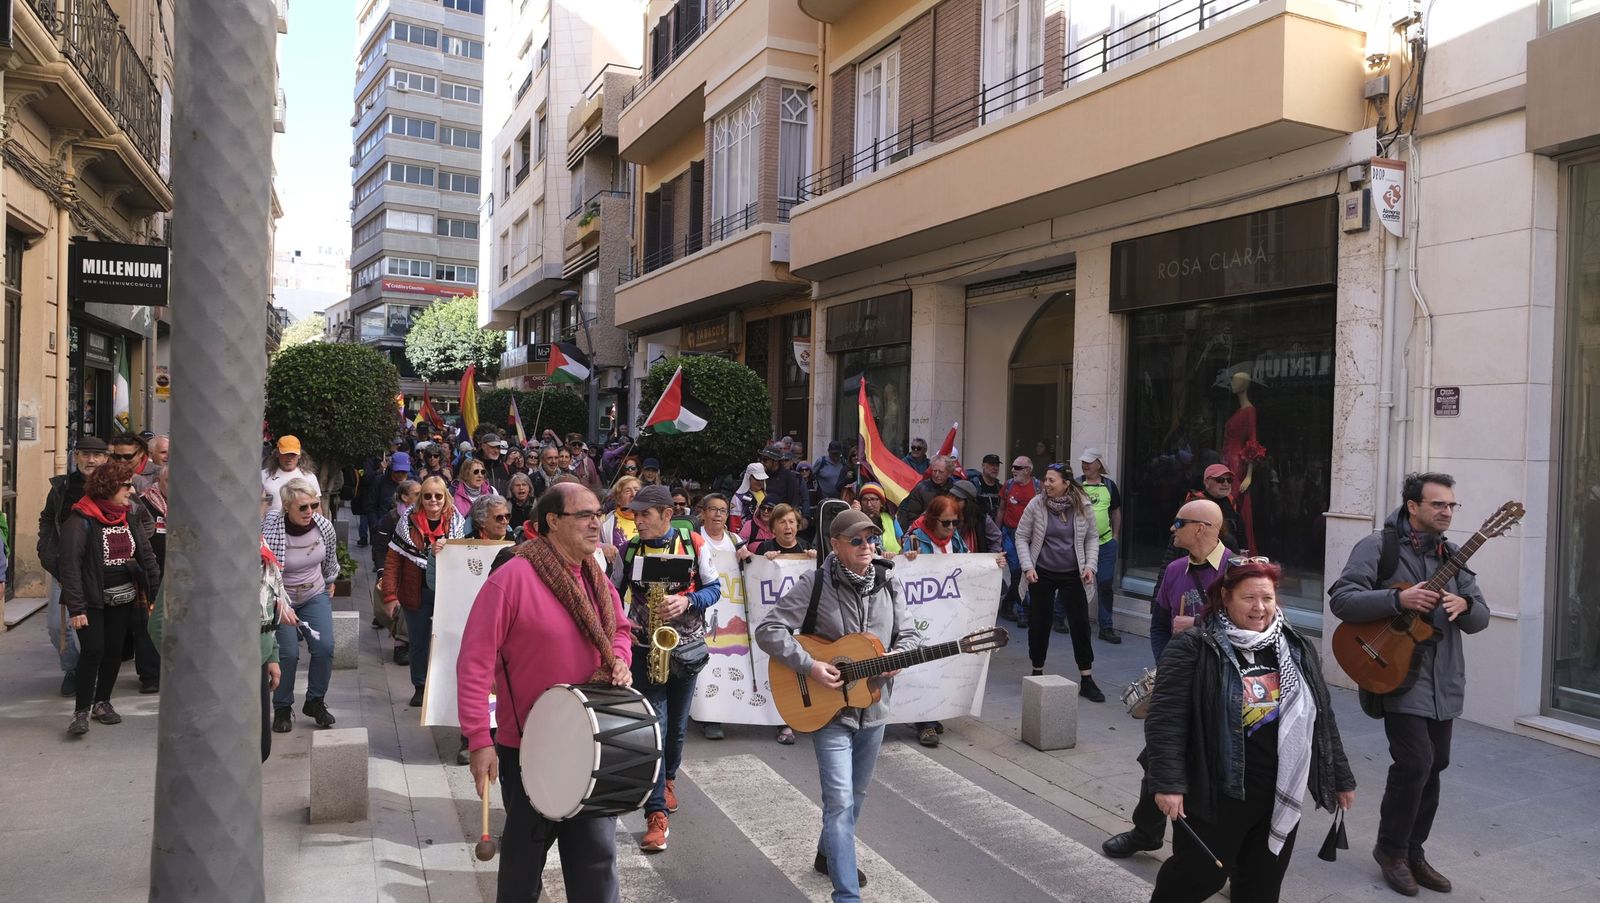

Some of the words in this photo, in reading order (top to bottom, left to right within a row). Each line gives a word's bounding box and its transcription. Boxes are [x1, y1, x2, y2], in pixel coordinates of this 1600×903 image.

[82, 258, 162, 279] MILLENIUM
[1158, 257, 1202, 279] ROSA
[1209, 240, 1267, 271] CLARÁ
[696, 323, 725, 340] TABACOS
[903, 567, 962, 605] NDÁ
[914, 618, 930, 631] re
